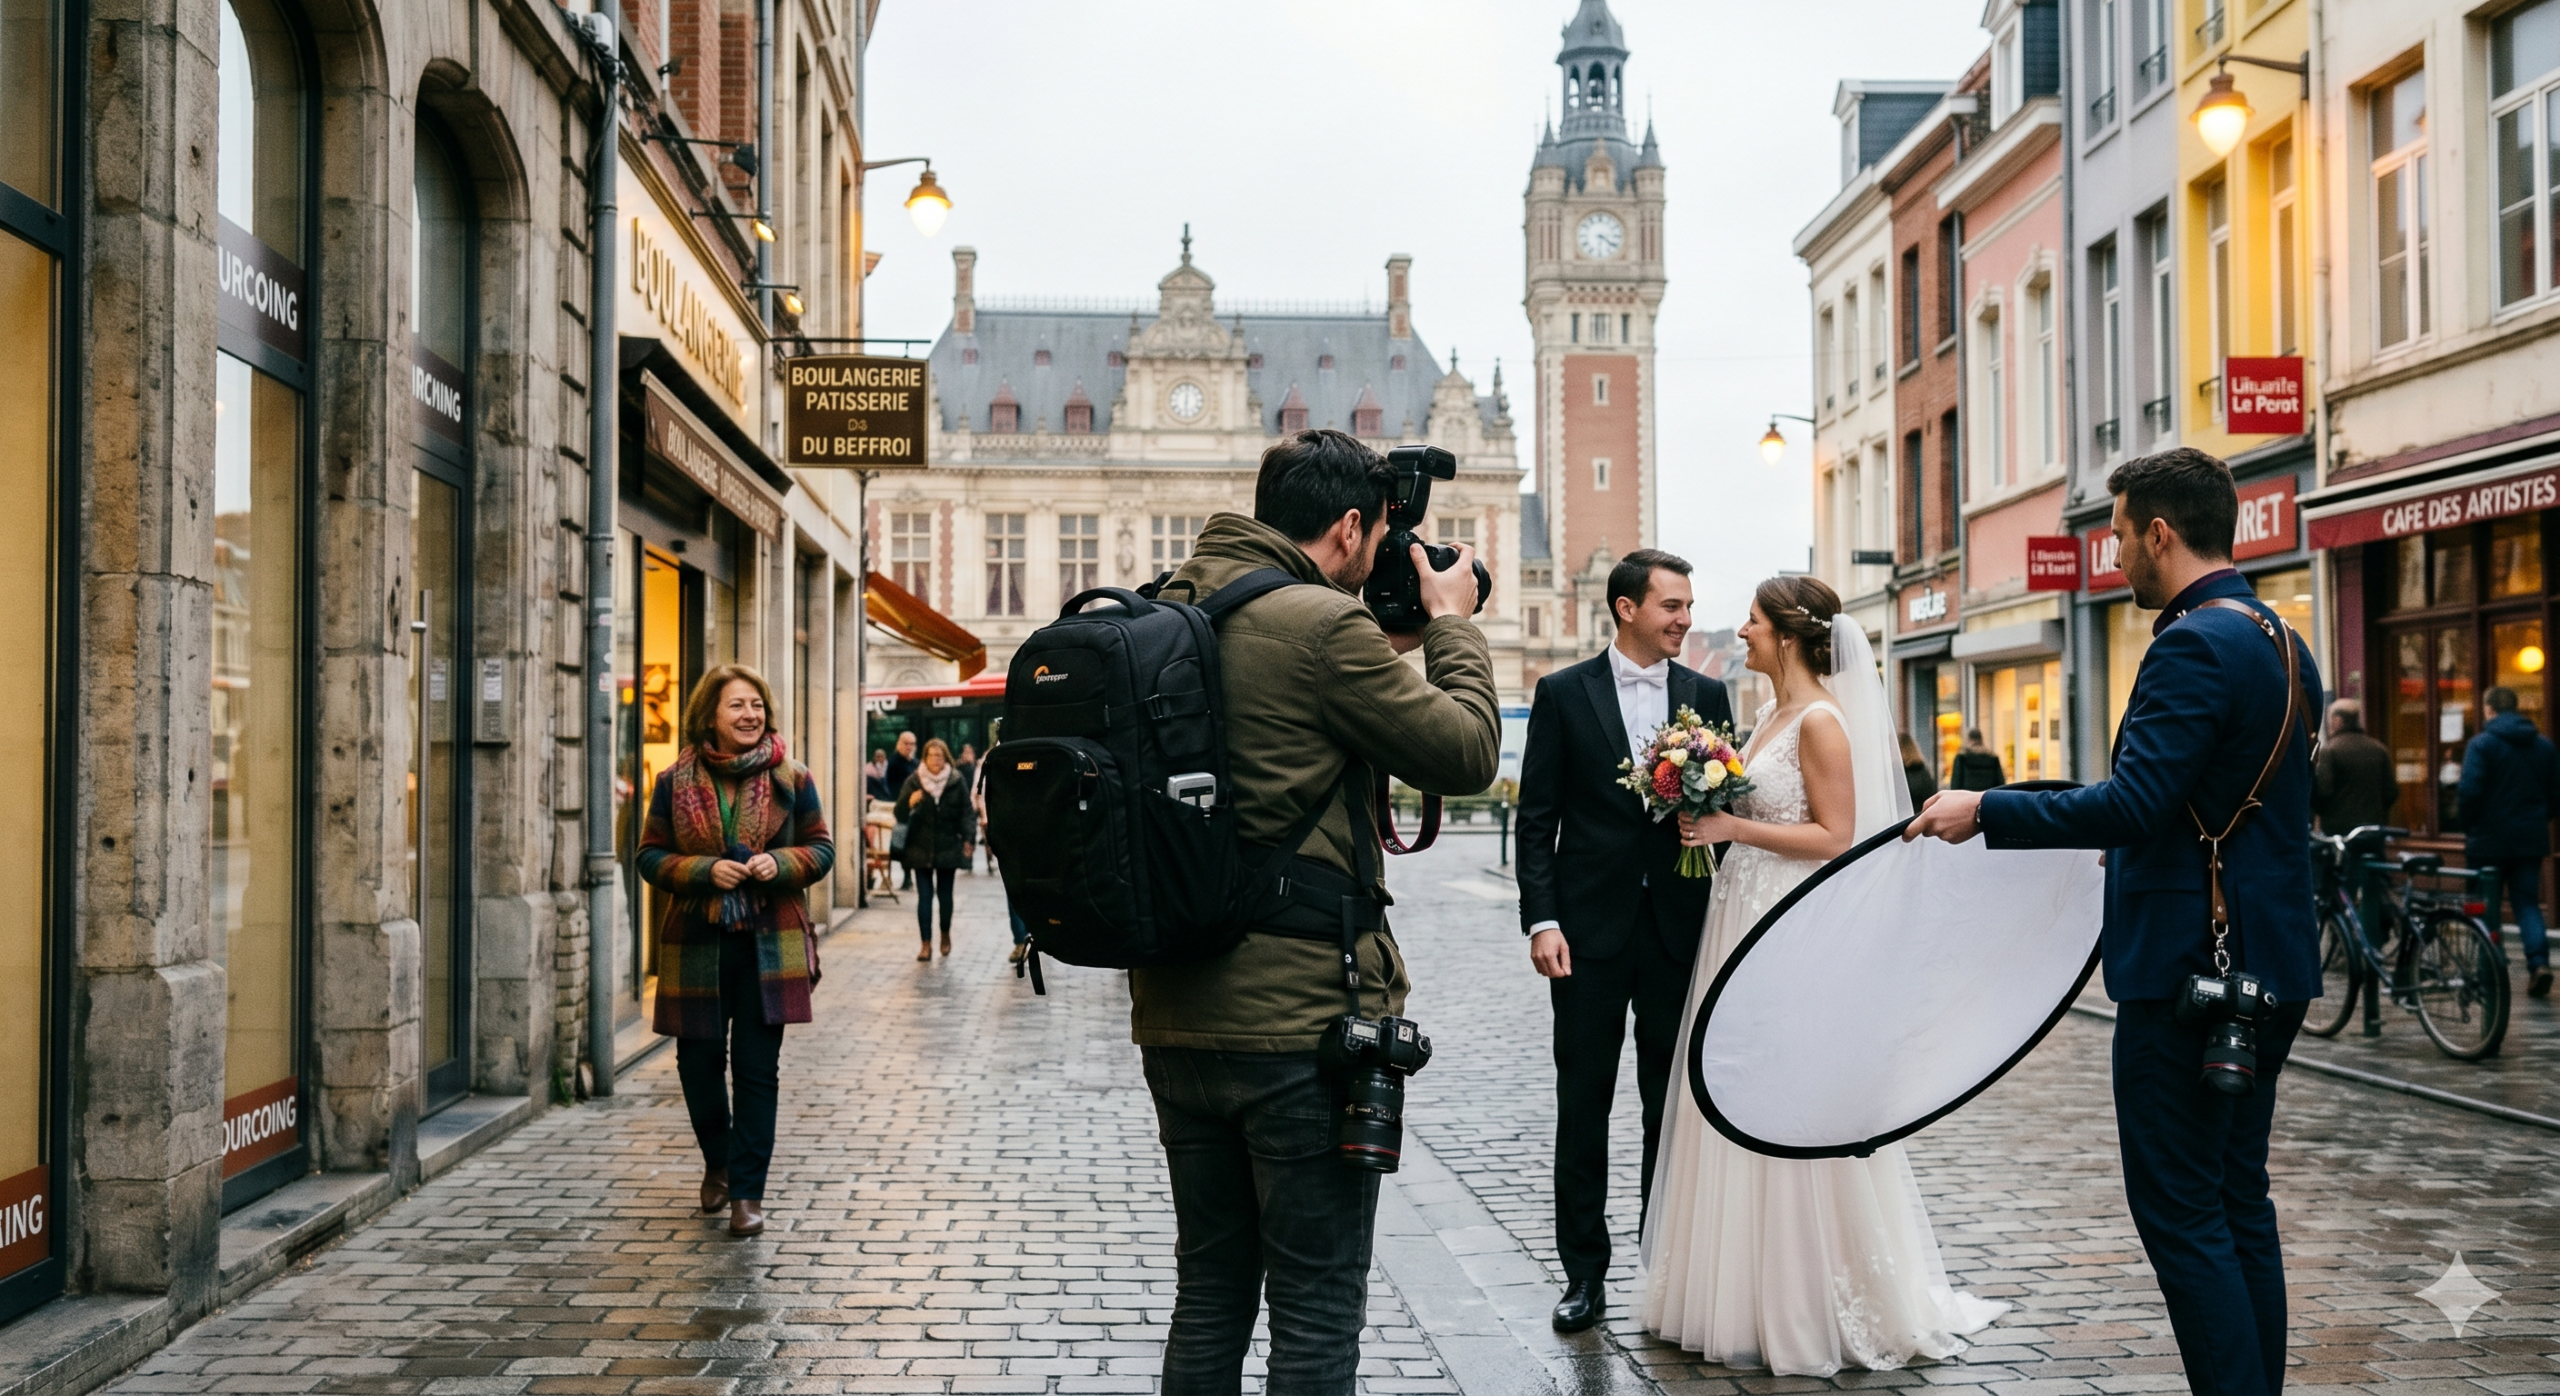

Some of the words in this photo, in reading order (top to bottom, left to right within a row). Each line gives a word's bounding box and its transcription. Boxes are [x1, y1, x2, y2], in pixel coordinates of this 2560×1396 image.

[218, 245, 297, 331] URCOING
[791, 366, 921, 387] BOULANGERIE
[806, 391, 909, 411] PATISSERIE
[2232, 395, 2253, 413] Le
[802, 436, 828, 455] DU
[833, 437, 911, 456] BEFFROI
[2382, 502, 2425, 536] CAFE
[2428, 494, 2462, 527] DES
[2465, 474, 2557, 520] ARTISTES
